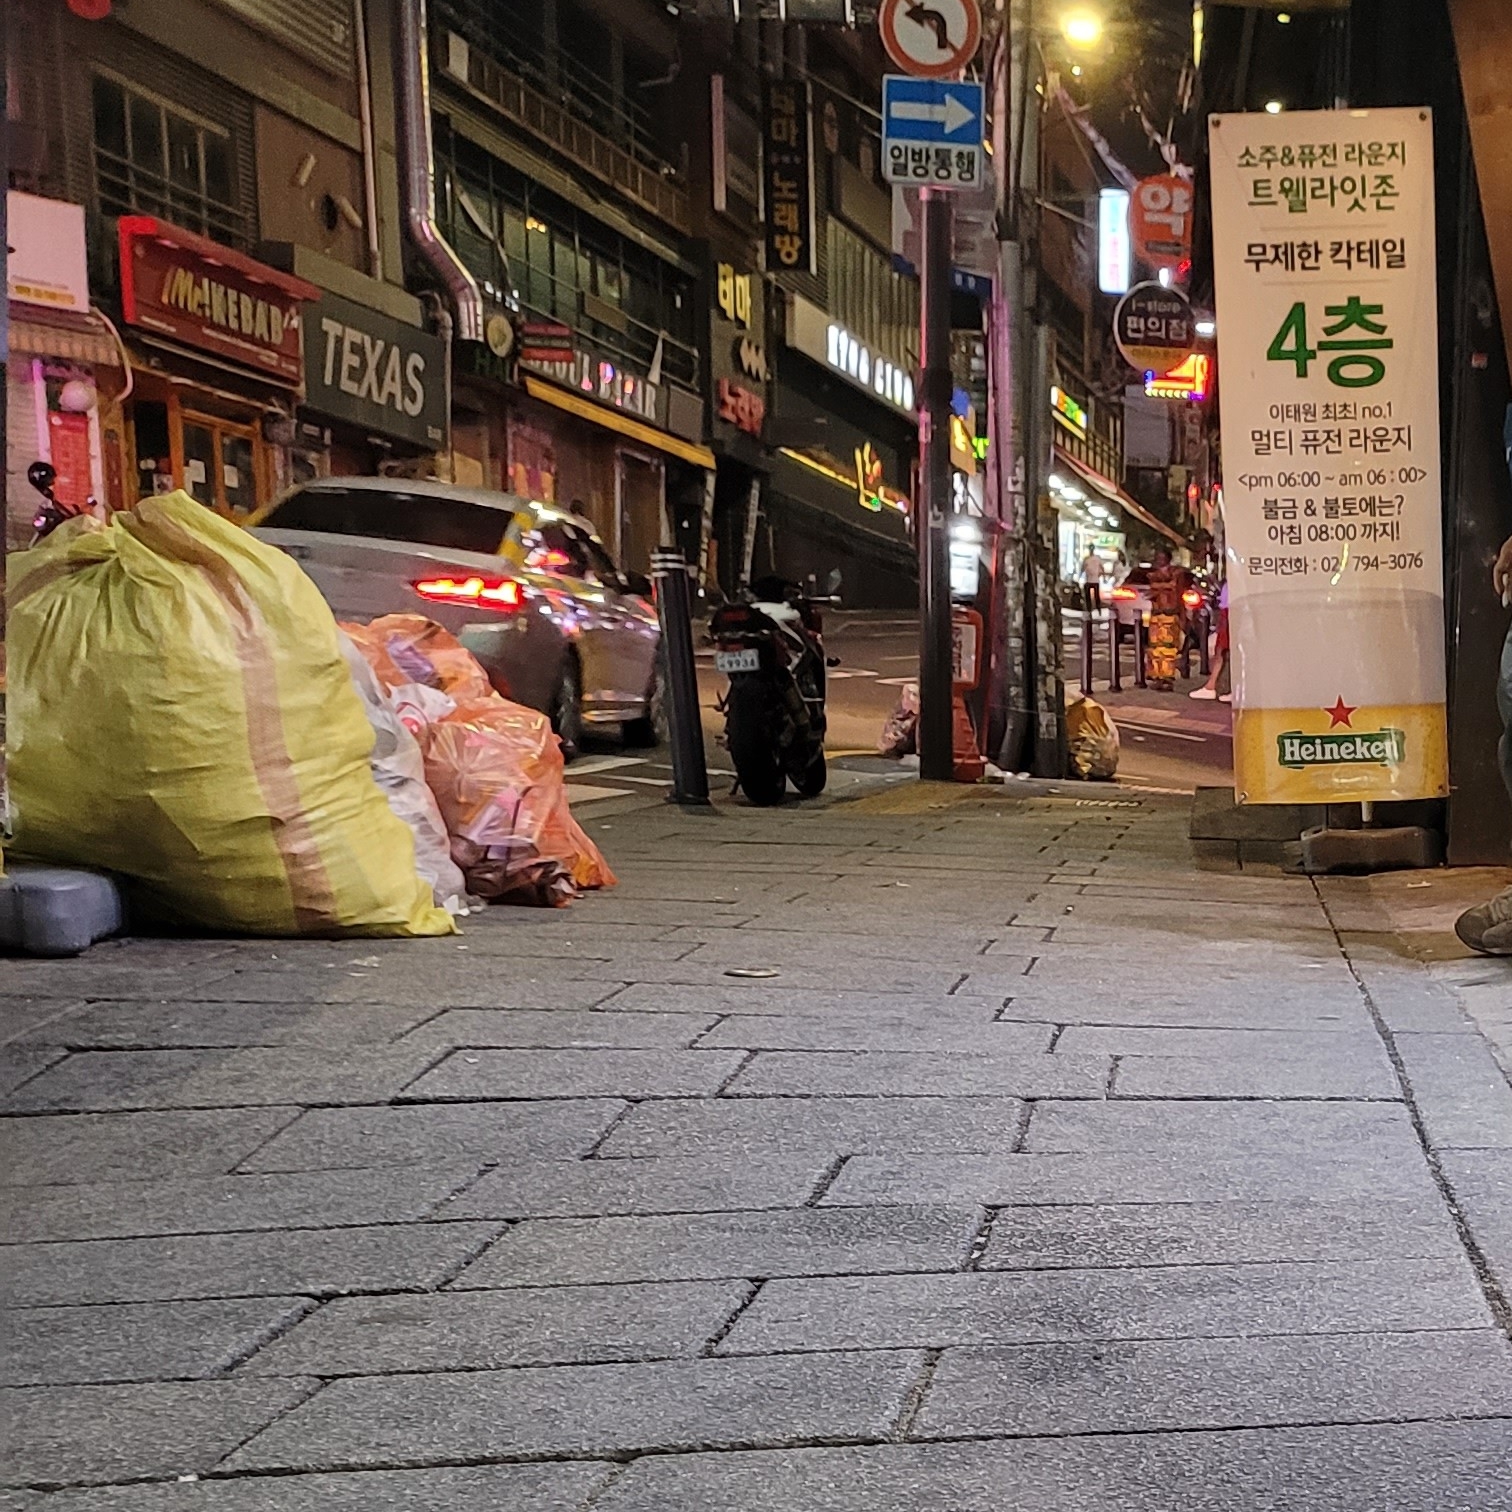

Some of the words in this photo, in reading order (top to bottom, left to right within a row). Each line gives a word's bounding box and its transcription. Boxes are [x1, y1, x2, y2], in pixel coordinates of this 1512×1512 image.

[890, 145, 976, 182] 일방통행
[1237, 142, 1338, 171] 소주&퓨전
[1344, 141, 1406, 168] 라운지
[1247, 174, 1400, 213] 트웰라잇존
[1141, 183, 1192, 236] 약
[1244, 240, 1323, 272] 무제한
[1329, 238, 1406, 270] 칵테일
[1127, 315, 1187, 340] 편의점
[1266, 296, 1394, 388] 4층
[321, 317, 426, 418] TEXAS
[1269, 402, 1317, 423] 이태원
[1362, 401, 1392, 419] no.1
[1251, 429, 1293, 456] 멀티
[1300, 427, 1342, 455] 퓨전
[1349, 425, 1412, 453] 라운지
[1238, 472, 1273, 491] <pm
[1277, 471, 1321, 487] 06:00
[1339, 473, 1363, 486] am
[1261, 497, 1298, 520] 불금
[1304, 499, 1317, 517] &
[1322, 494, 1405, 519] 불토에는?
[1268, 523, 1302, 545] 아침
[1307, 523, 1357, 541] 08:00
[1360, 521, 1400, 543] 까지!
[1248, 556, 1308, 576] 문의전화
[1353, 553, 1423, 571] 794-3076
[1283, 737, 1399, 761] Heineken
